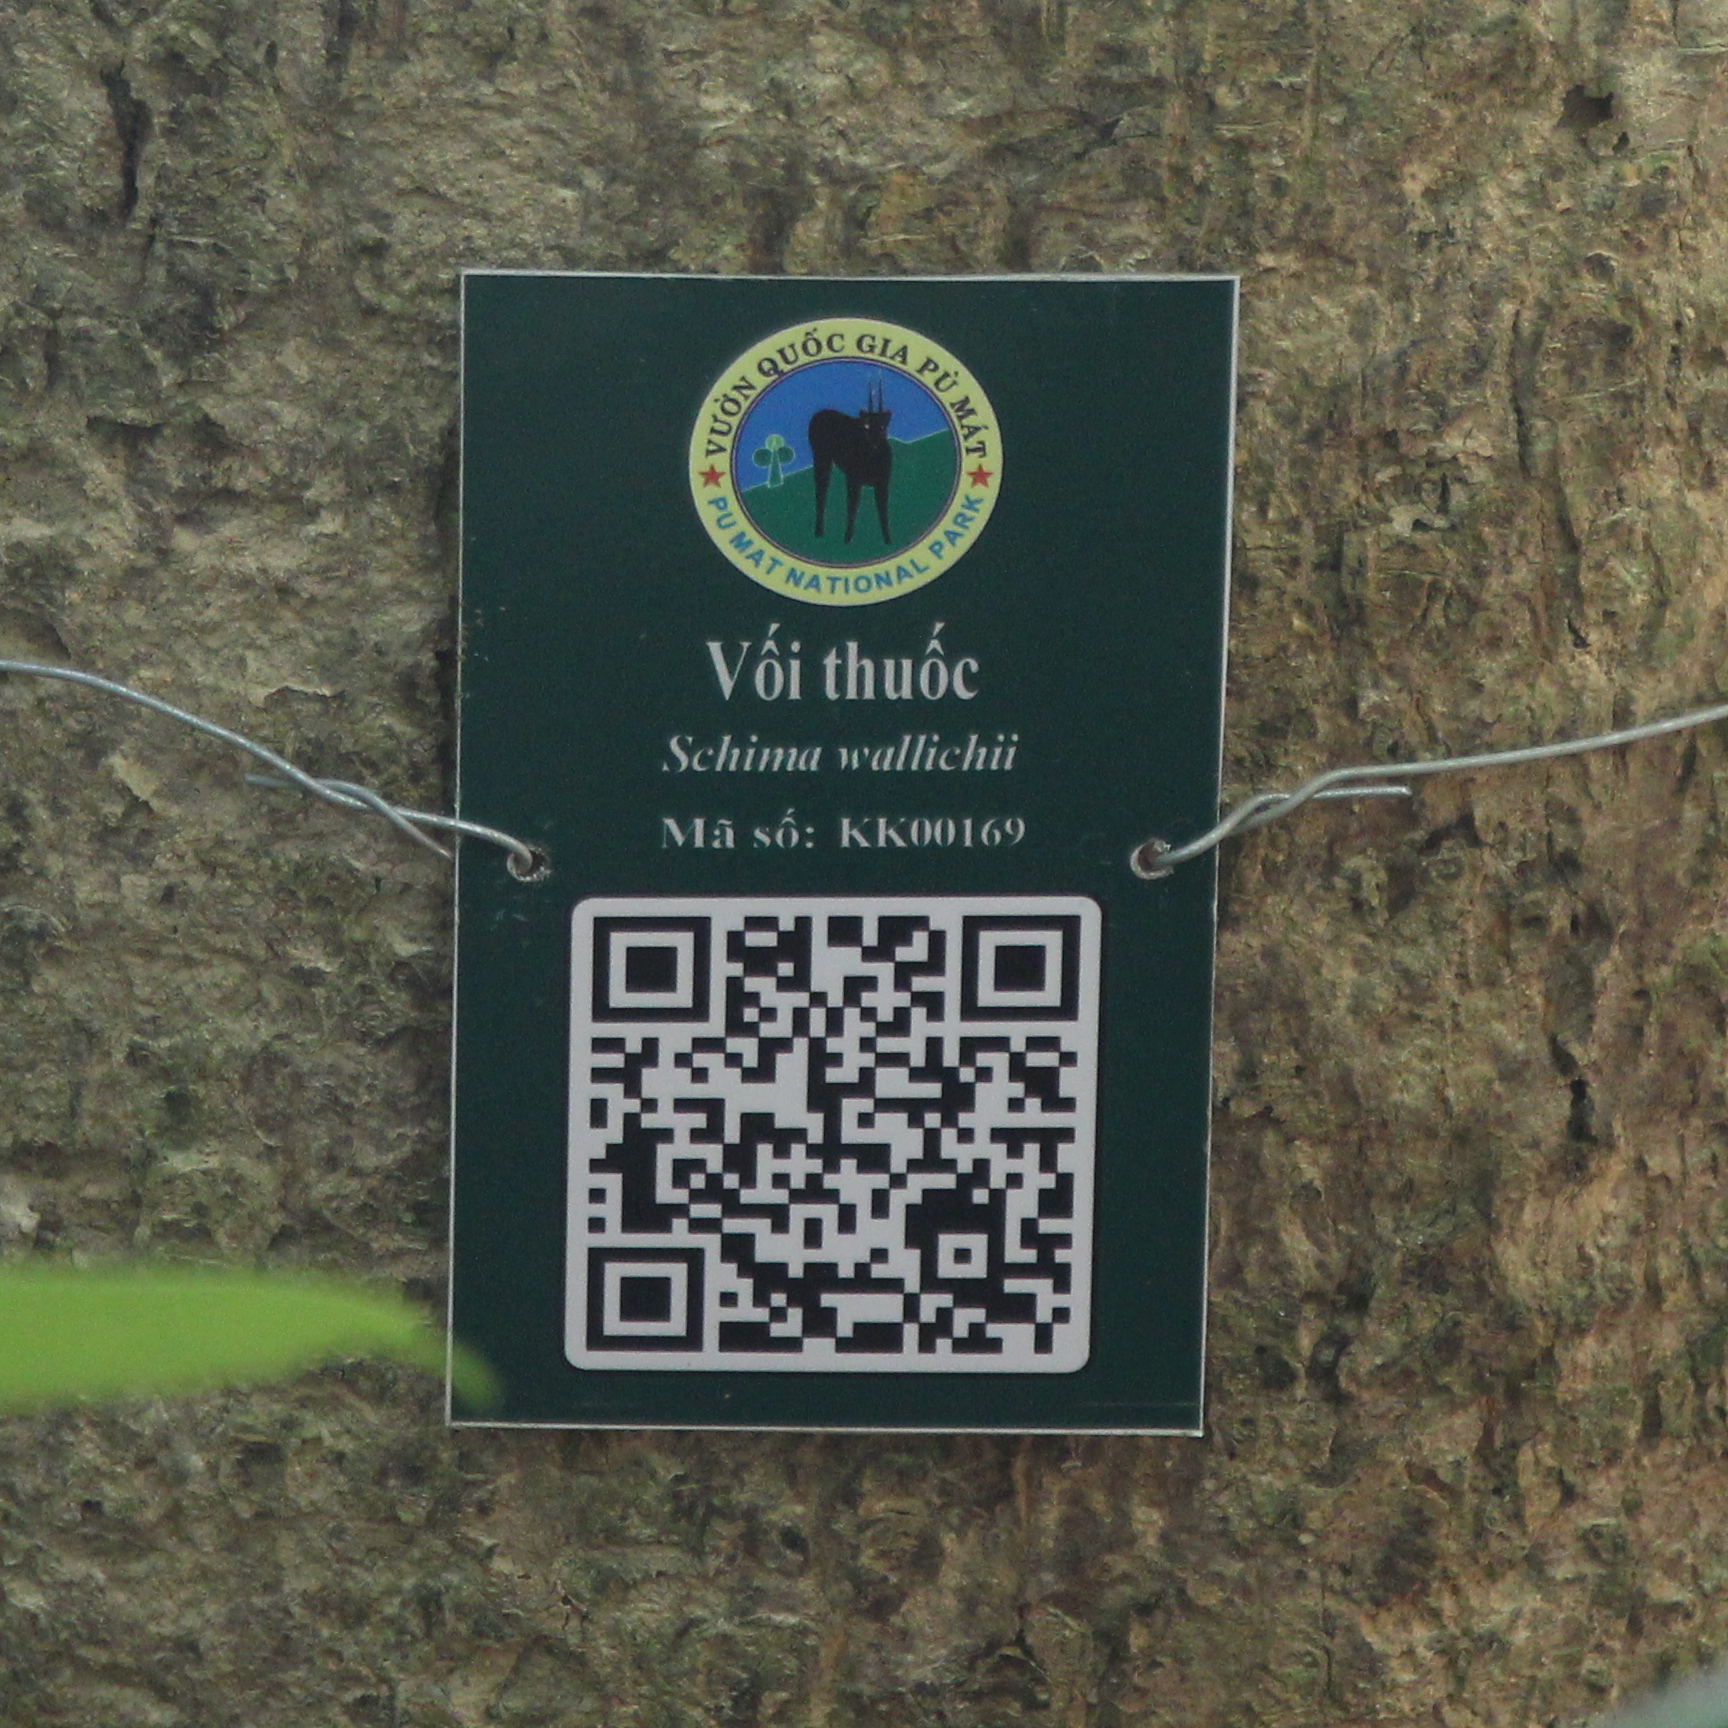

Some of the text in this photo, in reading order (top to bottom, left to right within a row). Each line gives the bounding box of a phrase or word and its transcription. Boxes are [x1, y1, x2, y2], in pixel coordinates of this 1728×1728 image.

[705, 327, 989, 459] VƯỜN QUỐC GIA PÙ MÁT
[707, 493, 985, 596] PU MAT NATIONAL PARK
[705, 621, 981, 701] Vối thuốc
[660, 733, 1021, 773] Schima wallichii
[660, 806, 1027, 850] Mã số: KK00169
